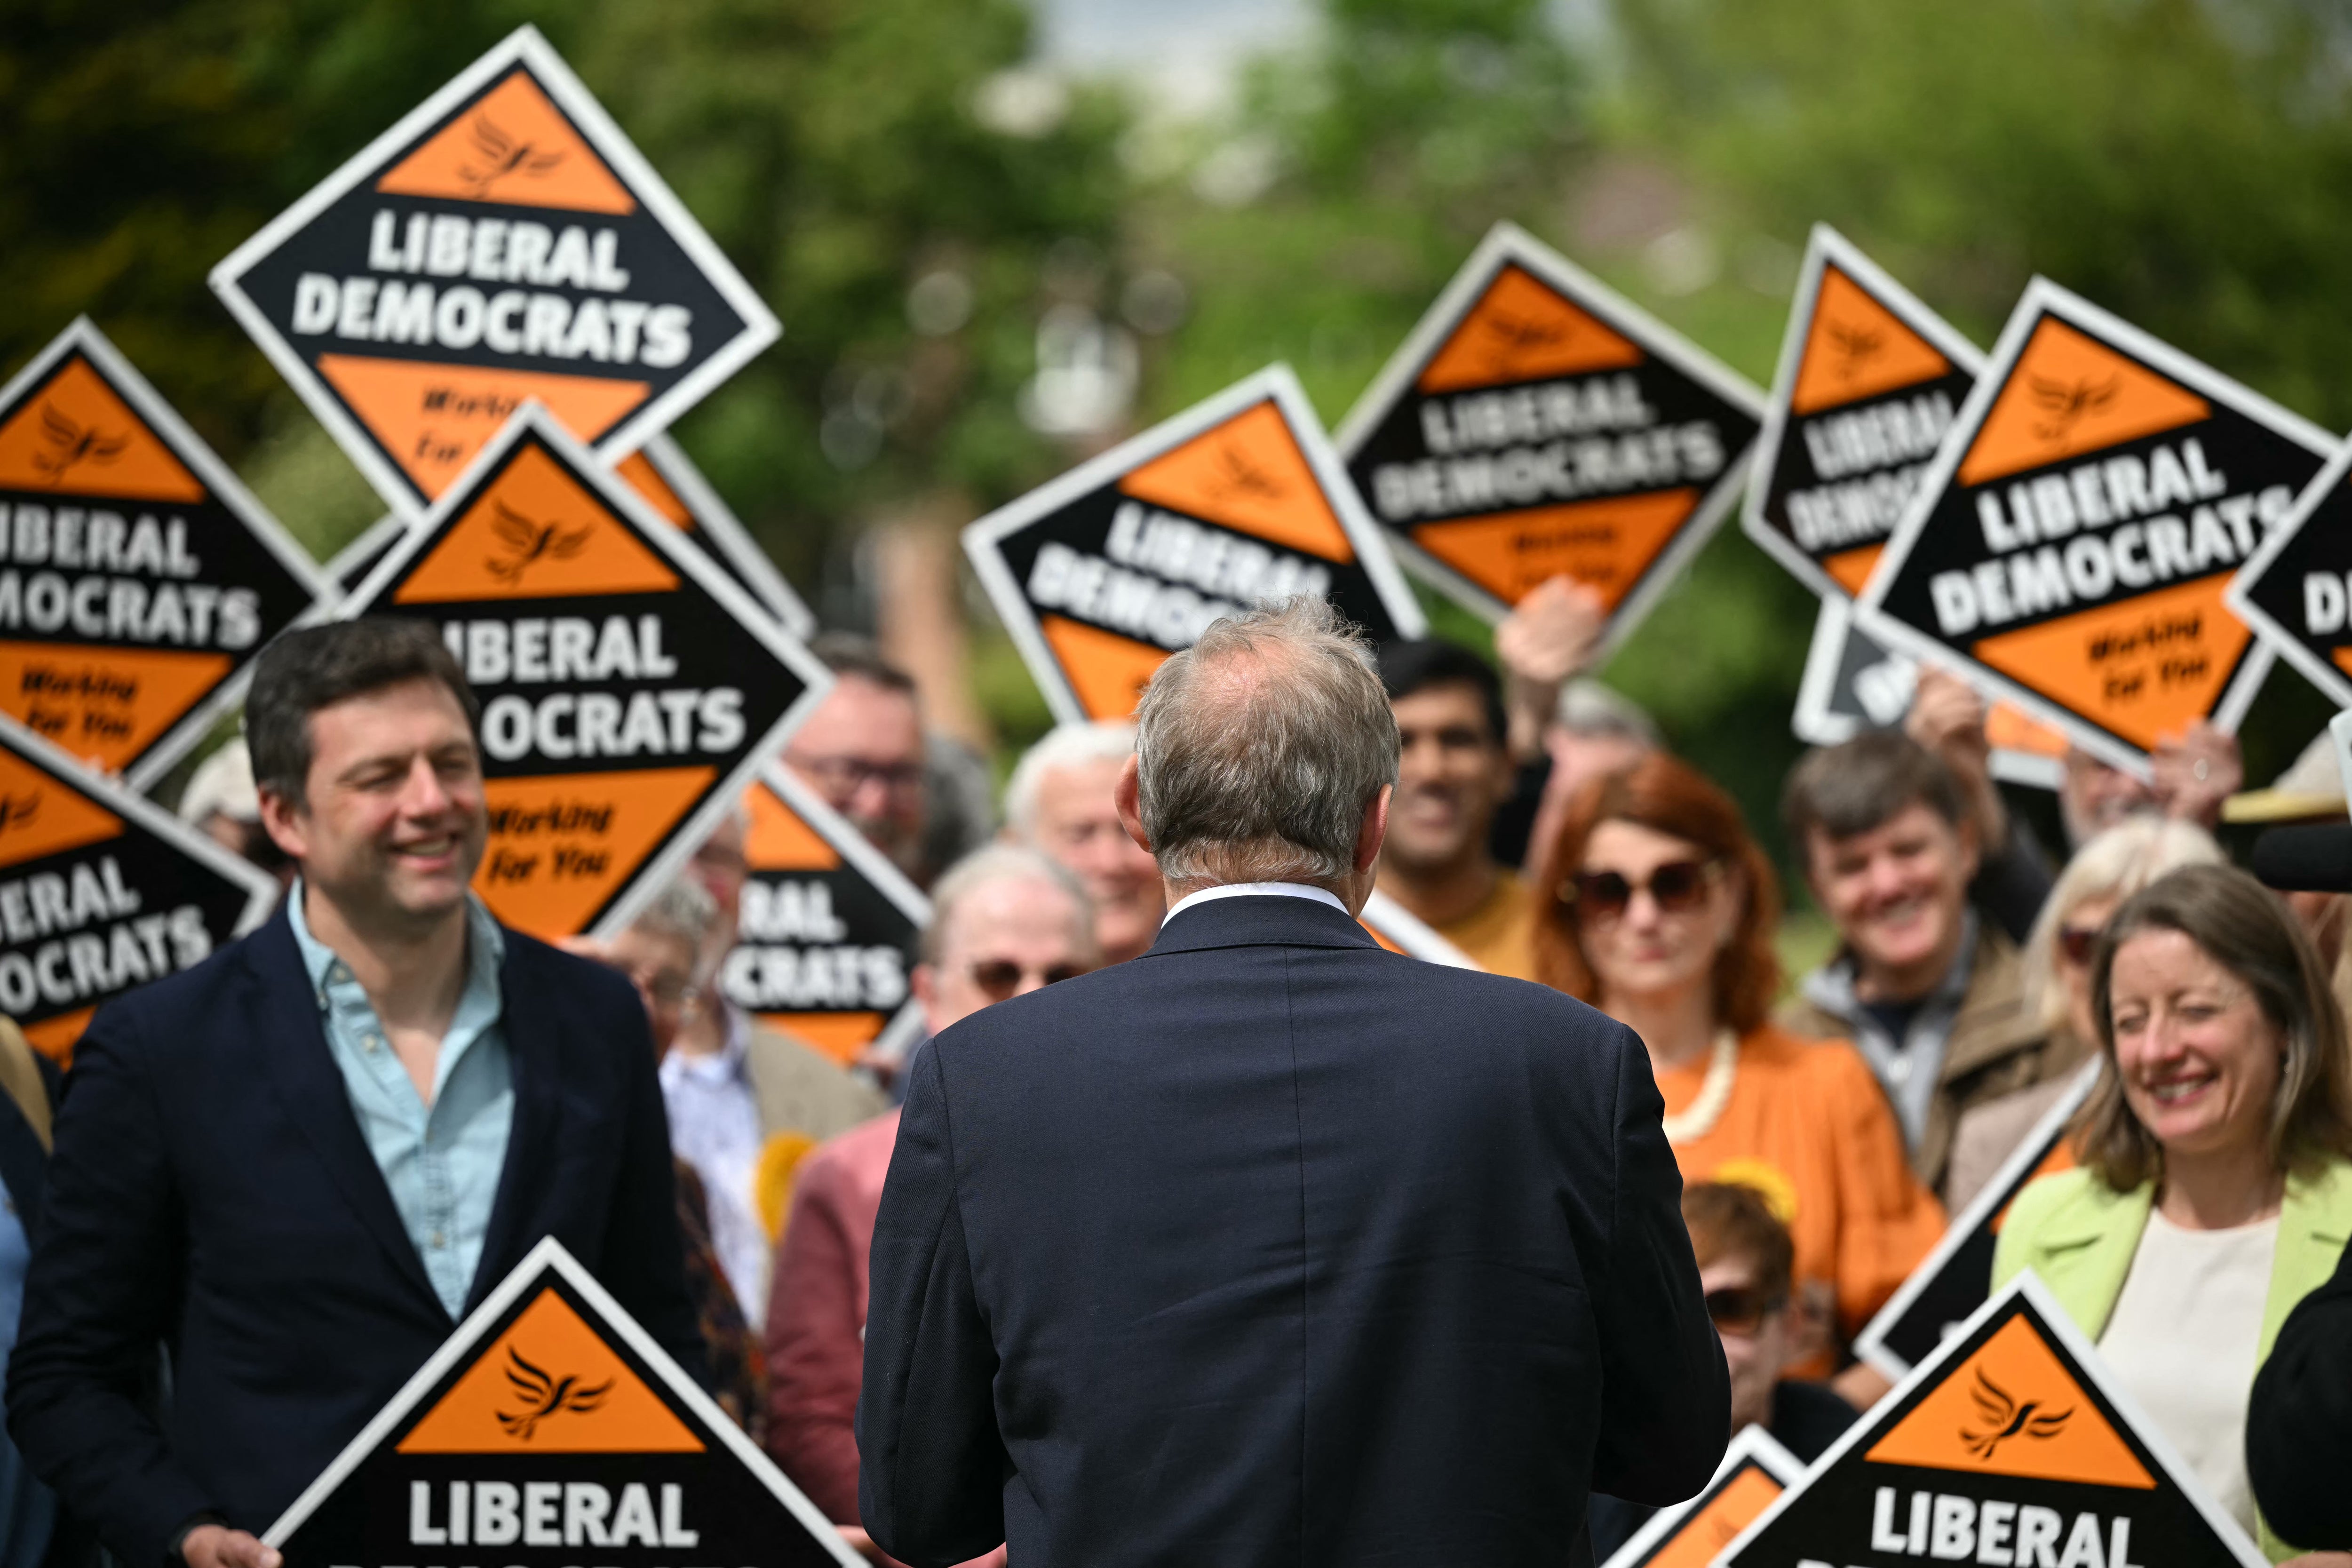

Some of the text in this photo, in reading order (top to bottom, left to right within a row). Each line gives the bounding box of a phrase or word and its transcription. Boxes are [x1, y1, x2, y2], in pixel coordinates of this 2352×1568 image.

[368, 209, 629, 293] LIBERAL
[292, 273, 693, 369] DEMOCRATS
[1420, 374, 1657, 454] LIBERAL
[1374, 420, 1724, 520] DEMOCRATS
[1977, 438, 2226, 553] LIBERAL
[1929, 485, 2293, 636] DEMOCRATS
[444, 613, 677, 685] IBERAL
[2088, 612, 2201, 664] Working
[21, 666, 137, 702] Working
[481, 687, 747, 762] OCRATS
[0, 854, 142, 943] ERAL
[0, 903, 212, 1016] OCRATS
[721, 943, 907, 1009] CRATS
[410, 1480, 699, 1547] LIBERAL
[1871, 1486, 2146, 1568] LIBERAL
